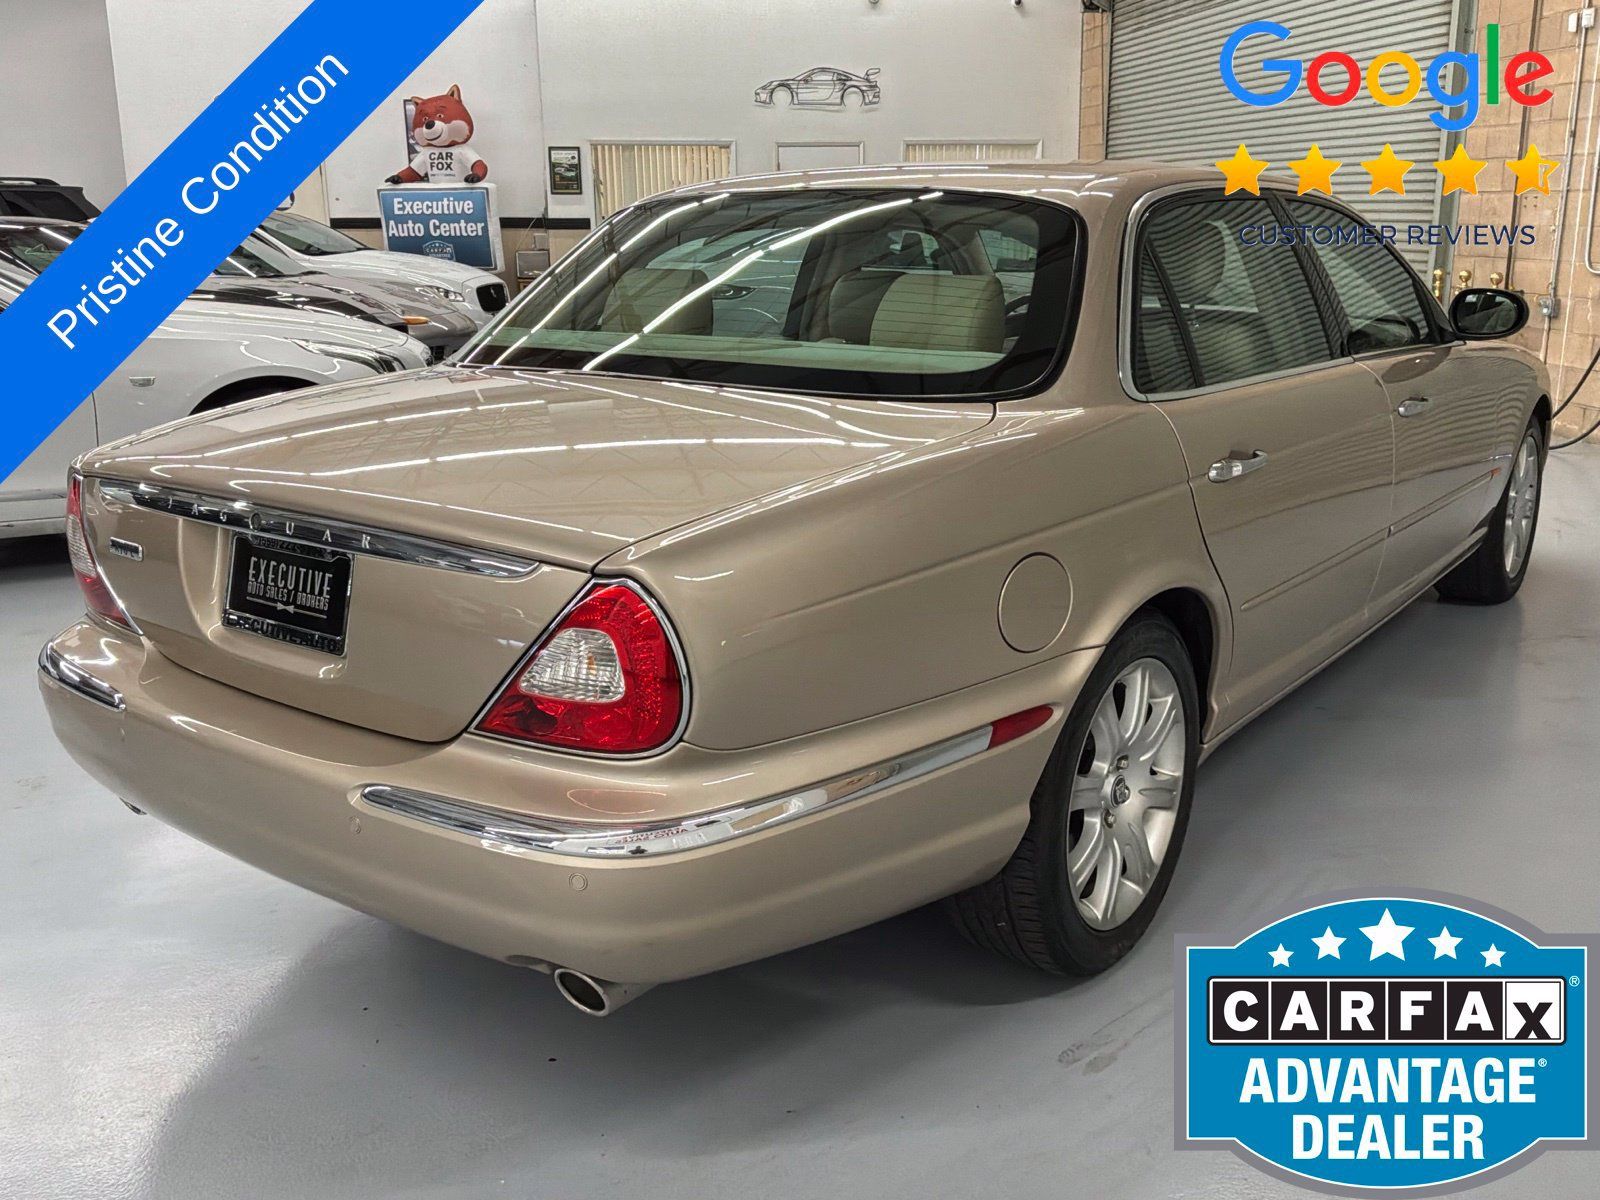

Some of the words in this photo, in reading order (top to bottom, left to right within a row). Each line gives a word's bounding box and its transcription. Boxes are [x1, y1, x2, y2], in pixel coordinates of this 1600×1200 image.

[428, 151, 454, 161] CAR
[429, 161, 454, 172] FOX
[393, 197, 474, 215] Executive
[388, 220, 424, 237] Auto
[429, 219, 485, 237] Center
[248, 556, 333, 598] EXECUTIVE
[266, 585, 287, 601] SALES
[296, 592, 329, 611] BROKERS
